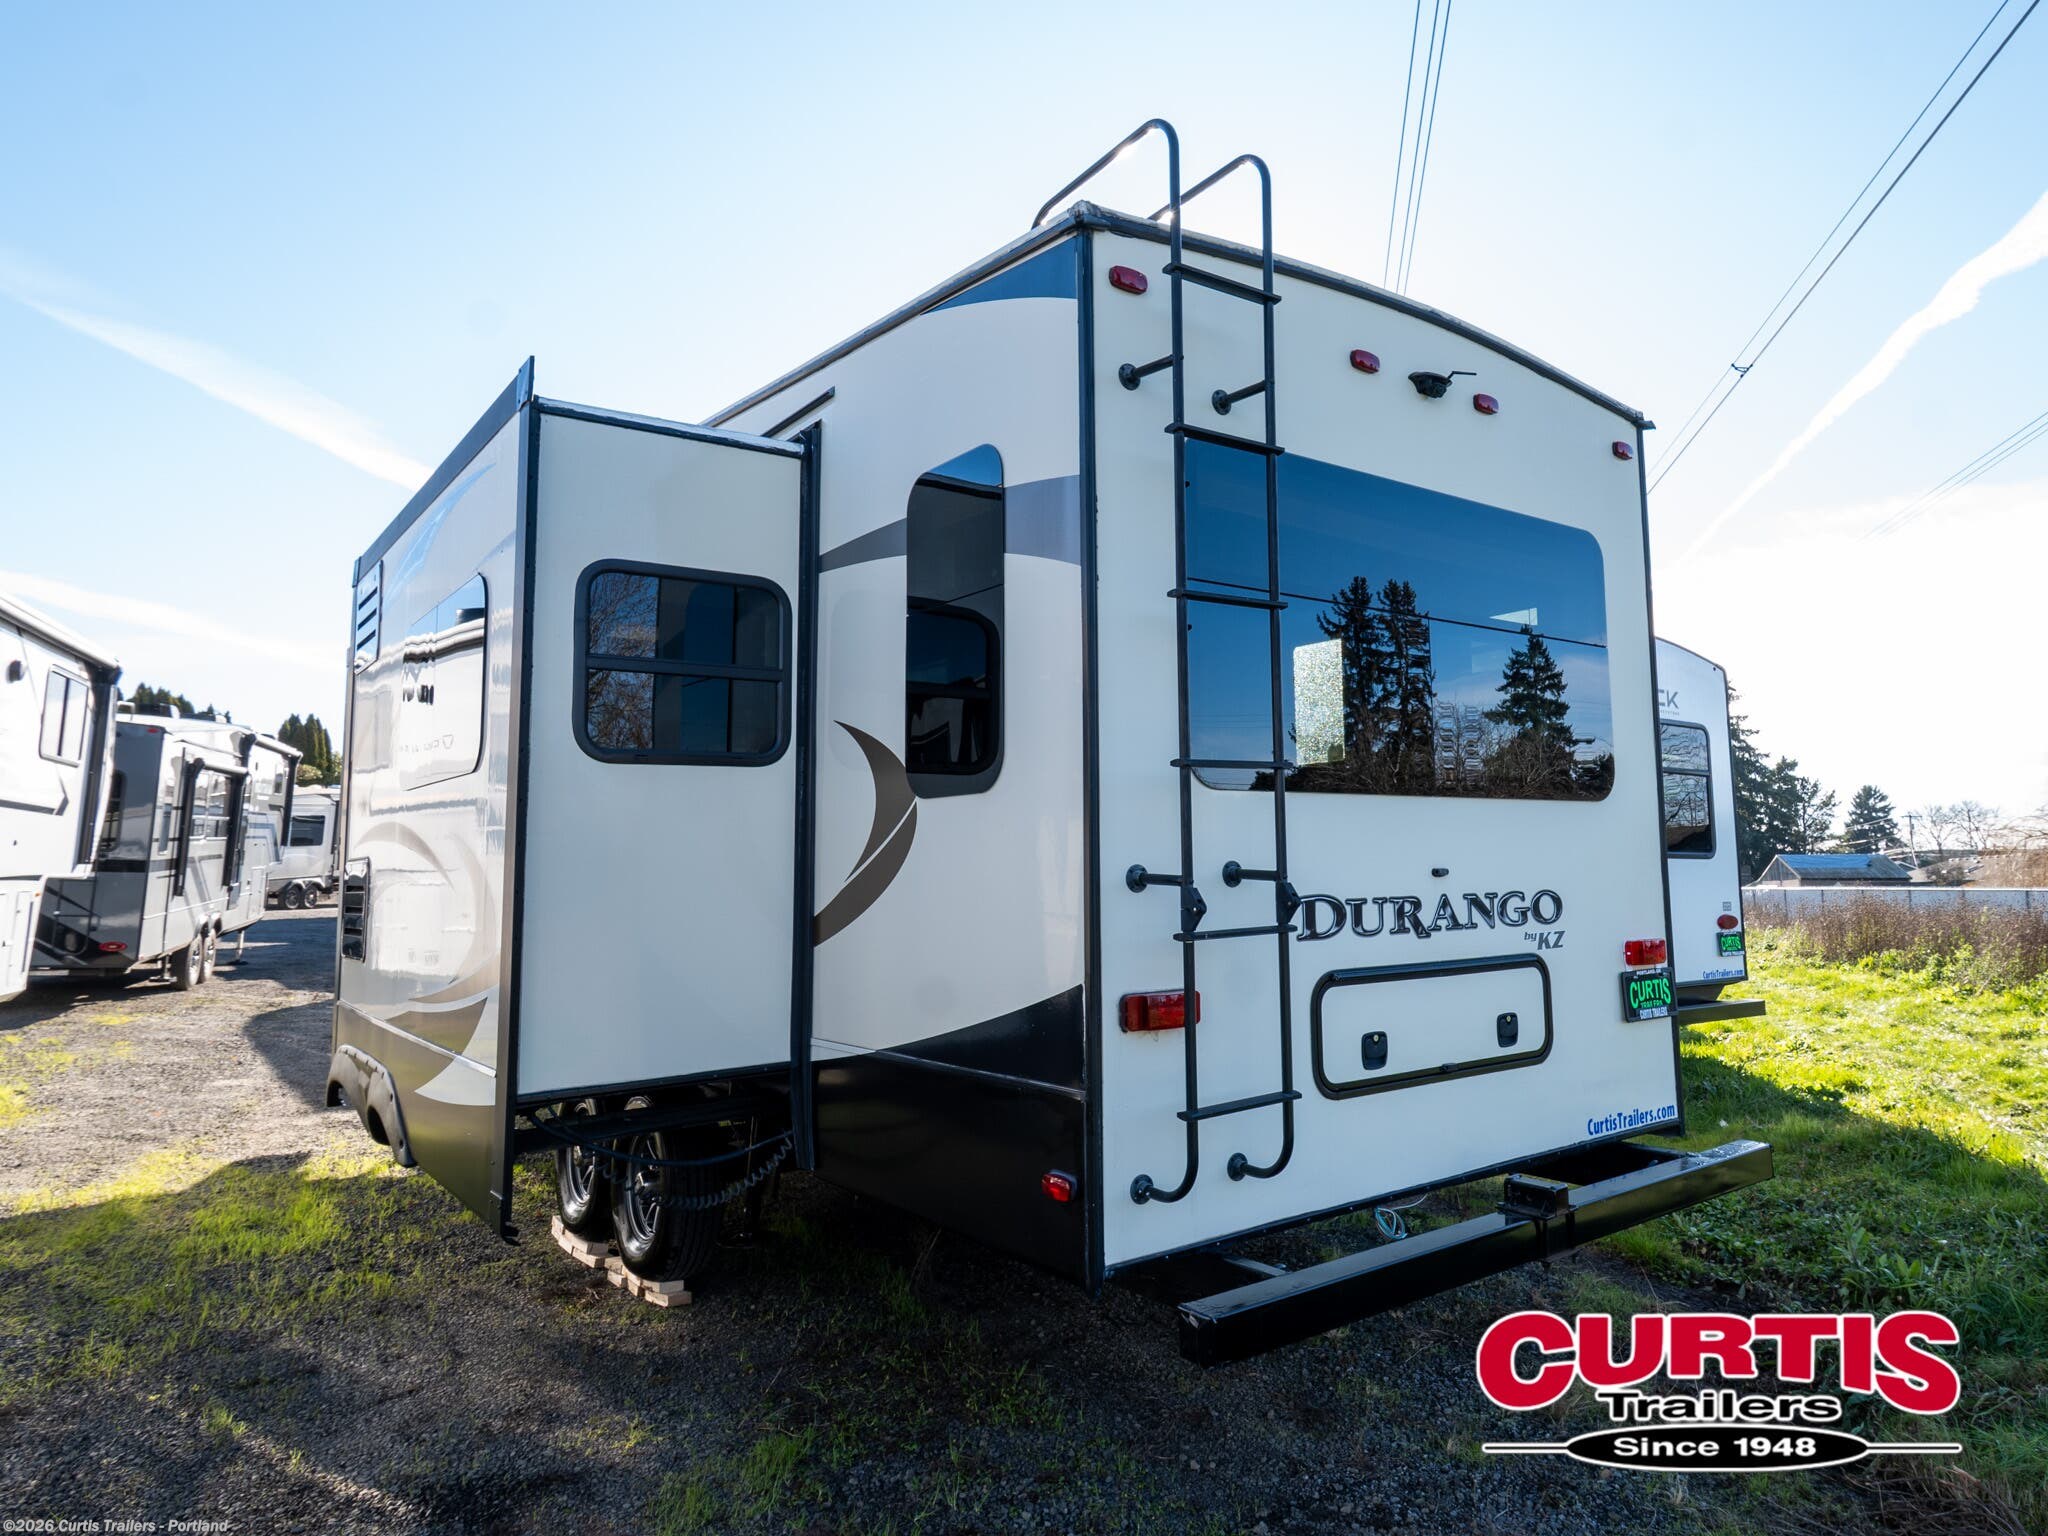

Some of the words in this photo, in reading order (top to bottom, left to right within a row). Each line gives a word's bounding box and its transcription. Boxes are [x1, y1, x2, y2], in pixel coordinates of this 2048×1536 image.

[1297, 889, 1563, 941] DURANGO
[1524, 931, 1537, 942] by
[1537, 931, 1565, 950] KZ
[1721, 936, 1741, 950] CURTIS
[1703, 969, 1743, 978] CurtisTrailers.com
[1630, 977, 1671, 1009] CURTIS
[1587, 1104, 1675, 1136] CurtisTrailers.com
